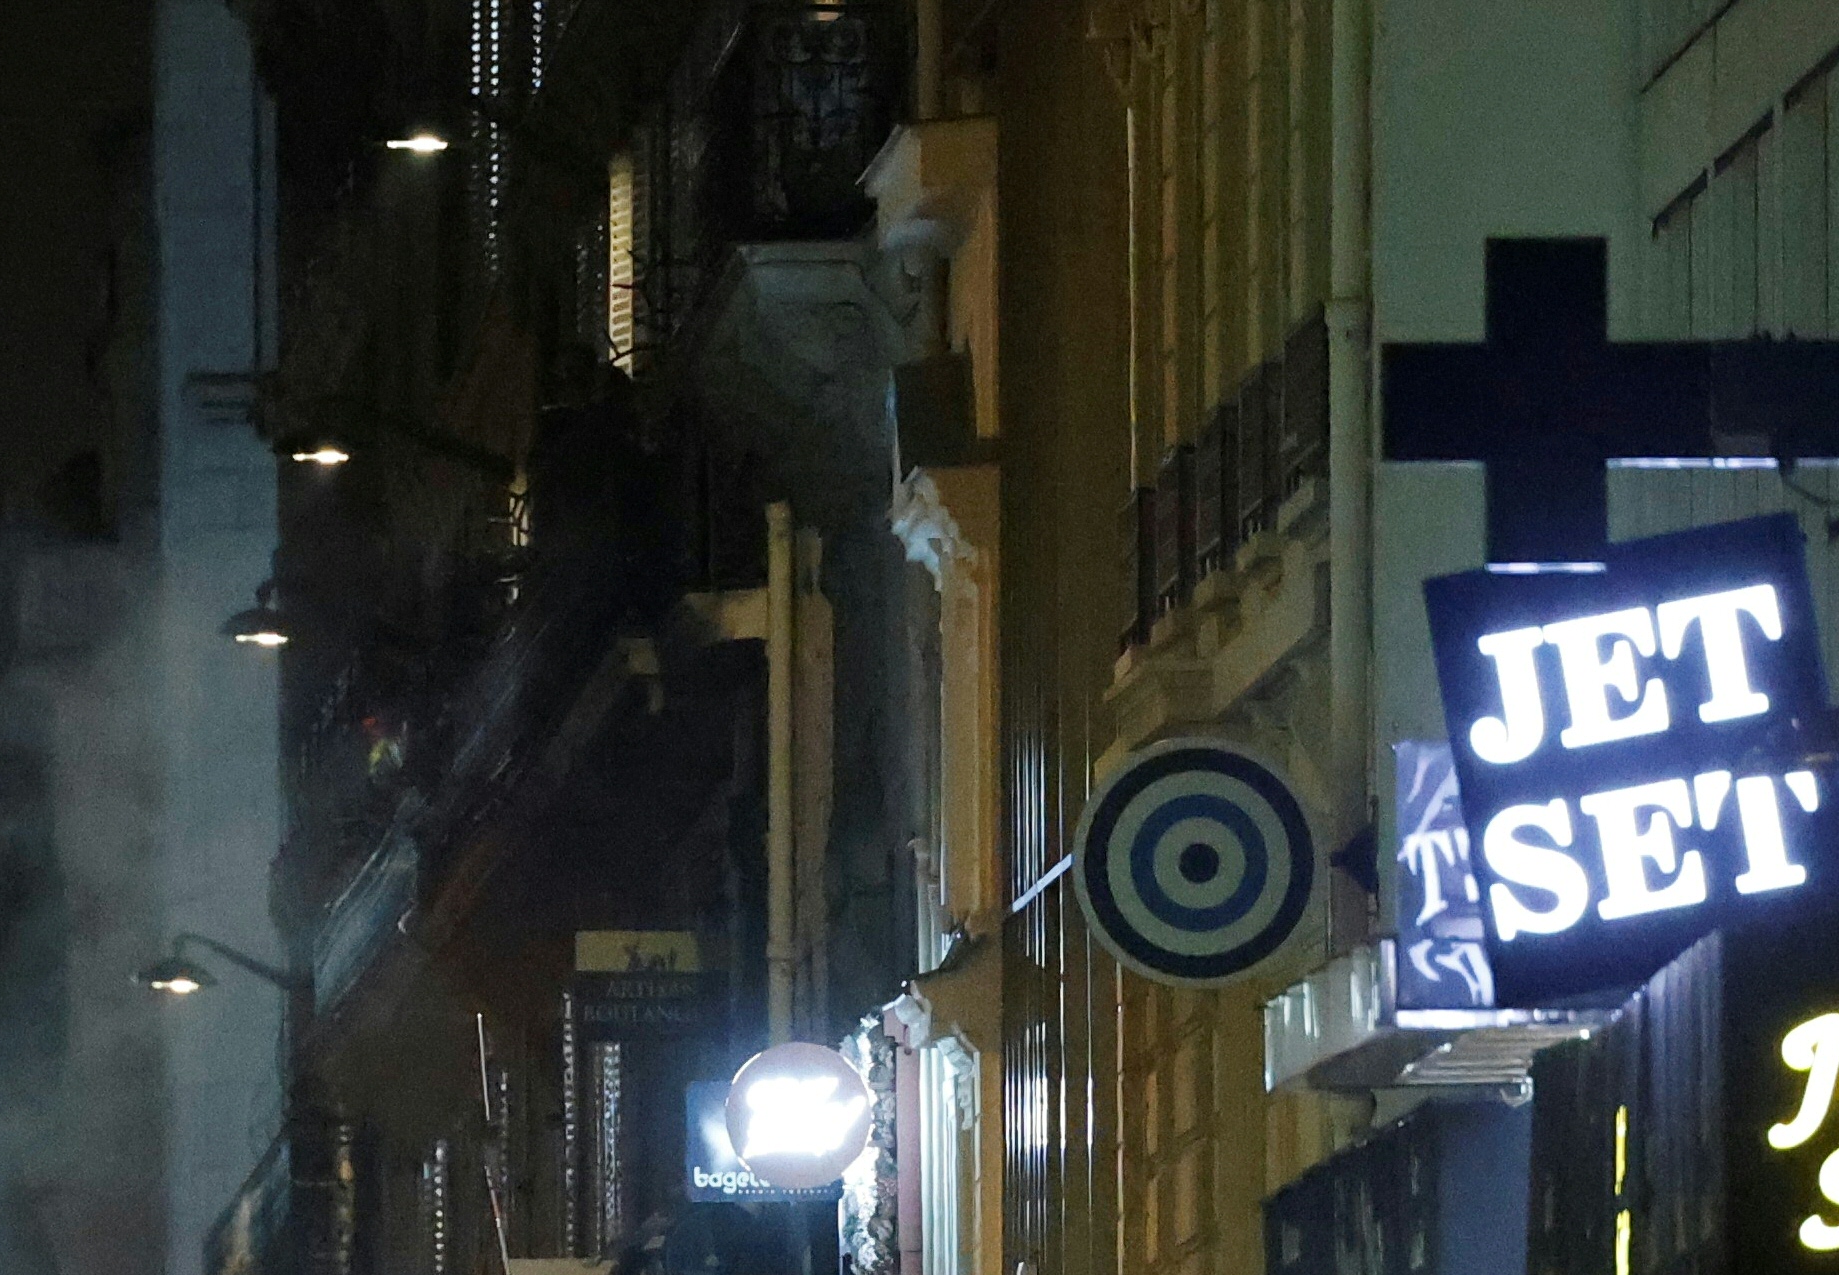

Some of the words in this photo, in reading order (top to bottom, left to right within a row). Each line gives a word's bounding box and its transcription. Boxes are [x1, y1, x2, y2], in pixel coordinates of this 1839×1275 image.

[1468, 583, 1784, 765] JET
[1481, 769, 1820, 943] SET
[692, 1166, 771, 1195] bagel
